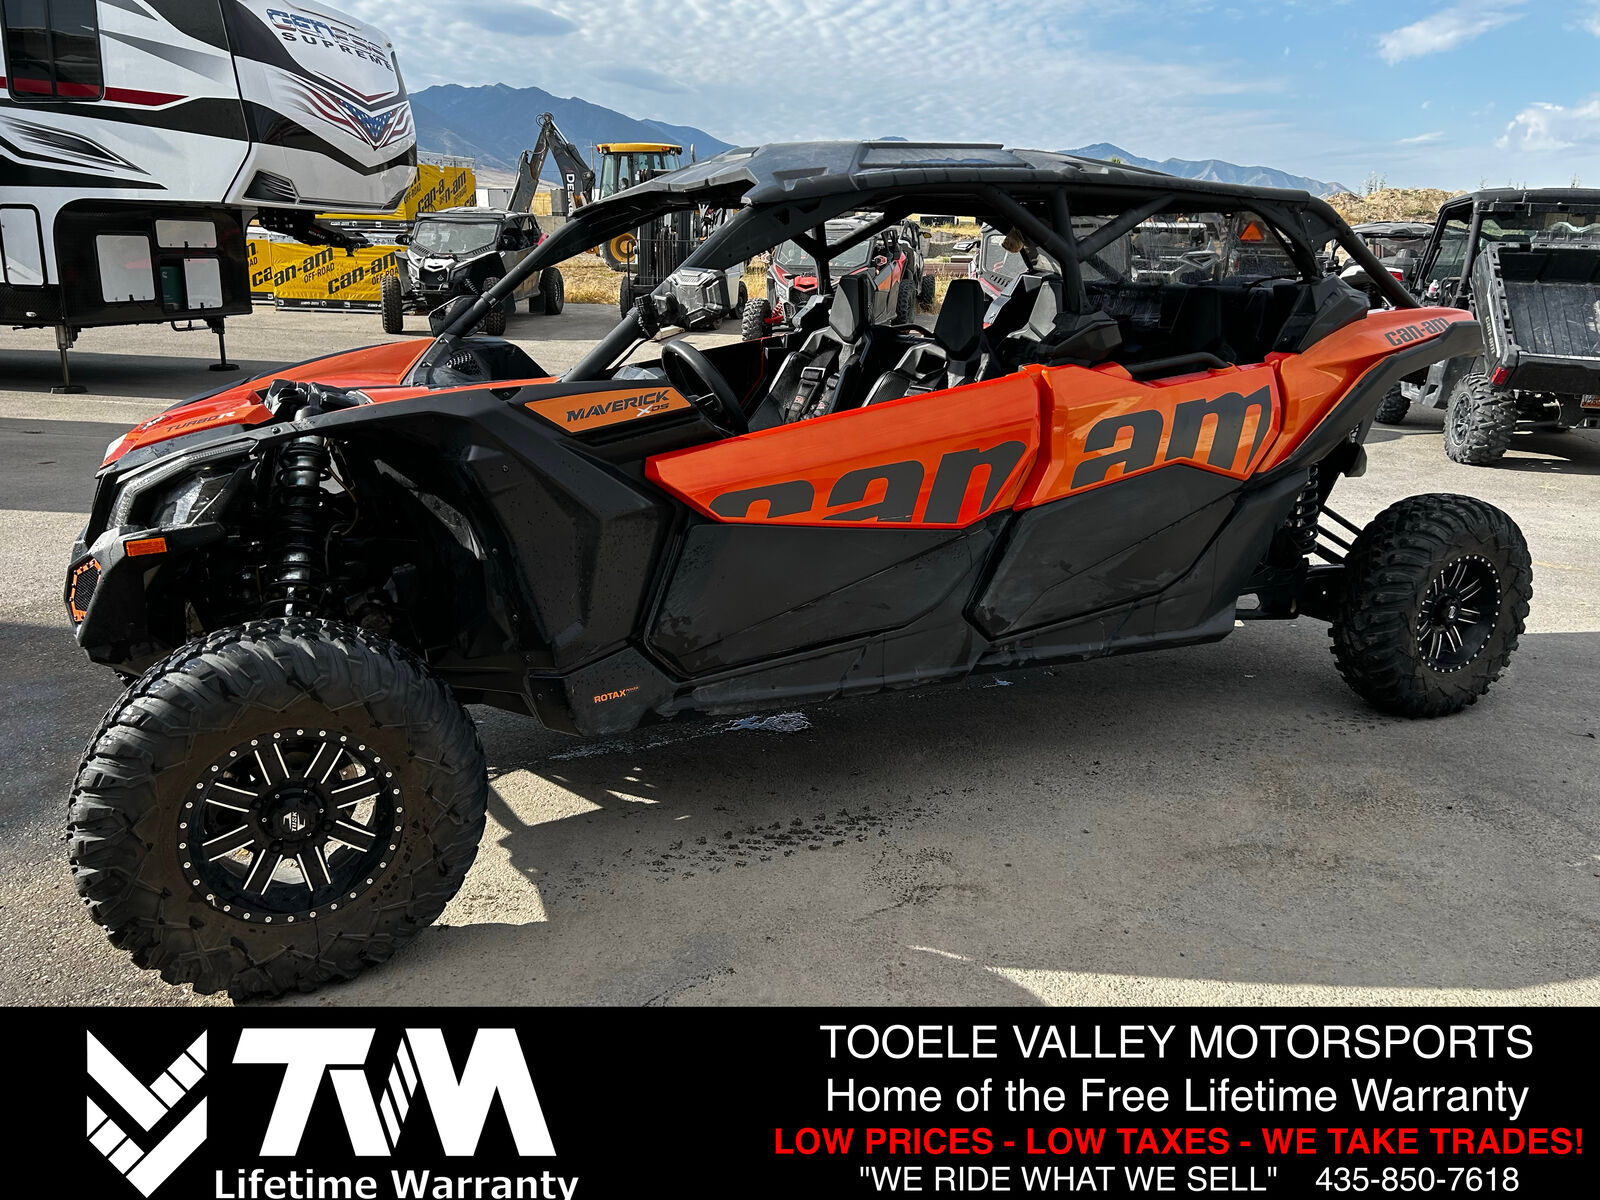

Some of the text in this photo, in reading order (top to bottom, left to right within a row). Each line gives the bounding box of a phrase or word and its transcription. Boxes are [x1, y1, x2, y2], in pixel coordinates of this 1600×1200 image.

[281, 32, 394, 72] SUPREME
[304, 263, 335, 284] OFF-ROAD
[1384, 317, 1450, 347] can-am
[567, 389, 670, 422] MAVERICK
[593, 689, 627, 704] ROTAX
